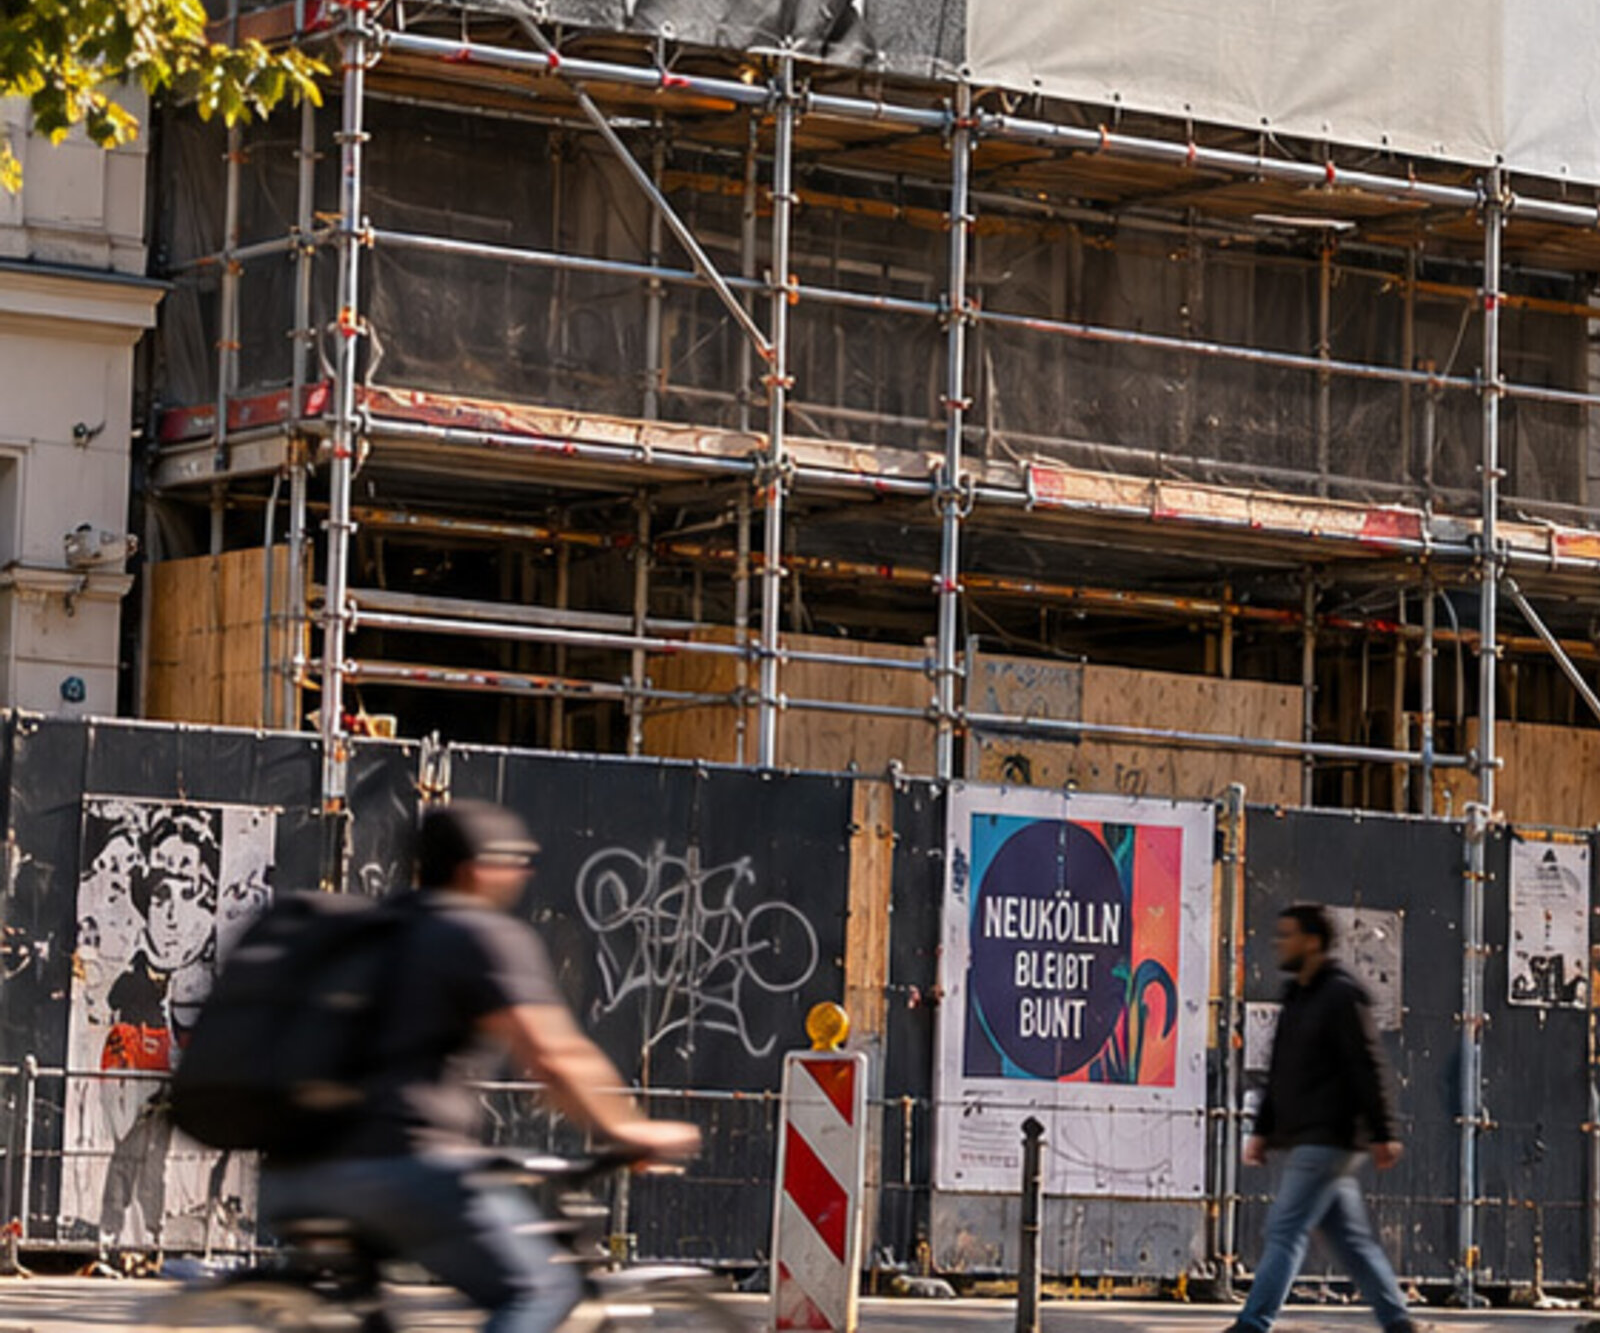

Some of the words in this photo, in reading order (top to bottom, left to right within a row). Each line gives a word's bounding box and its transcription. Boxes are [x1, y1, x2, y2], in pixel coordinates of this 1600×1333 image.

[984, 890, 1123, 945] NEUKÖLLN
[1014, 950, 1095, 991] BLEIBT
[1018, 996, 1089, 1042] BUNT
